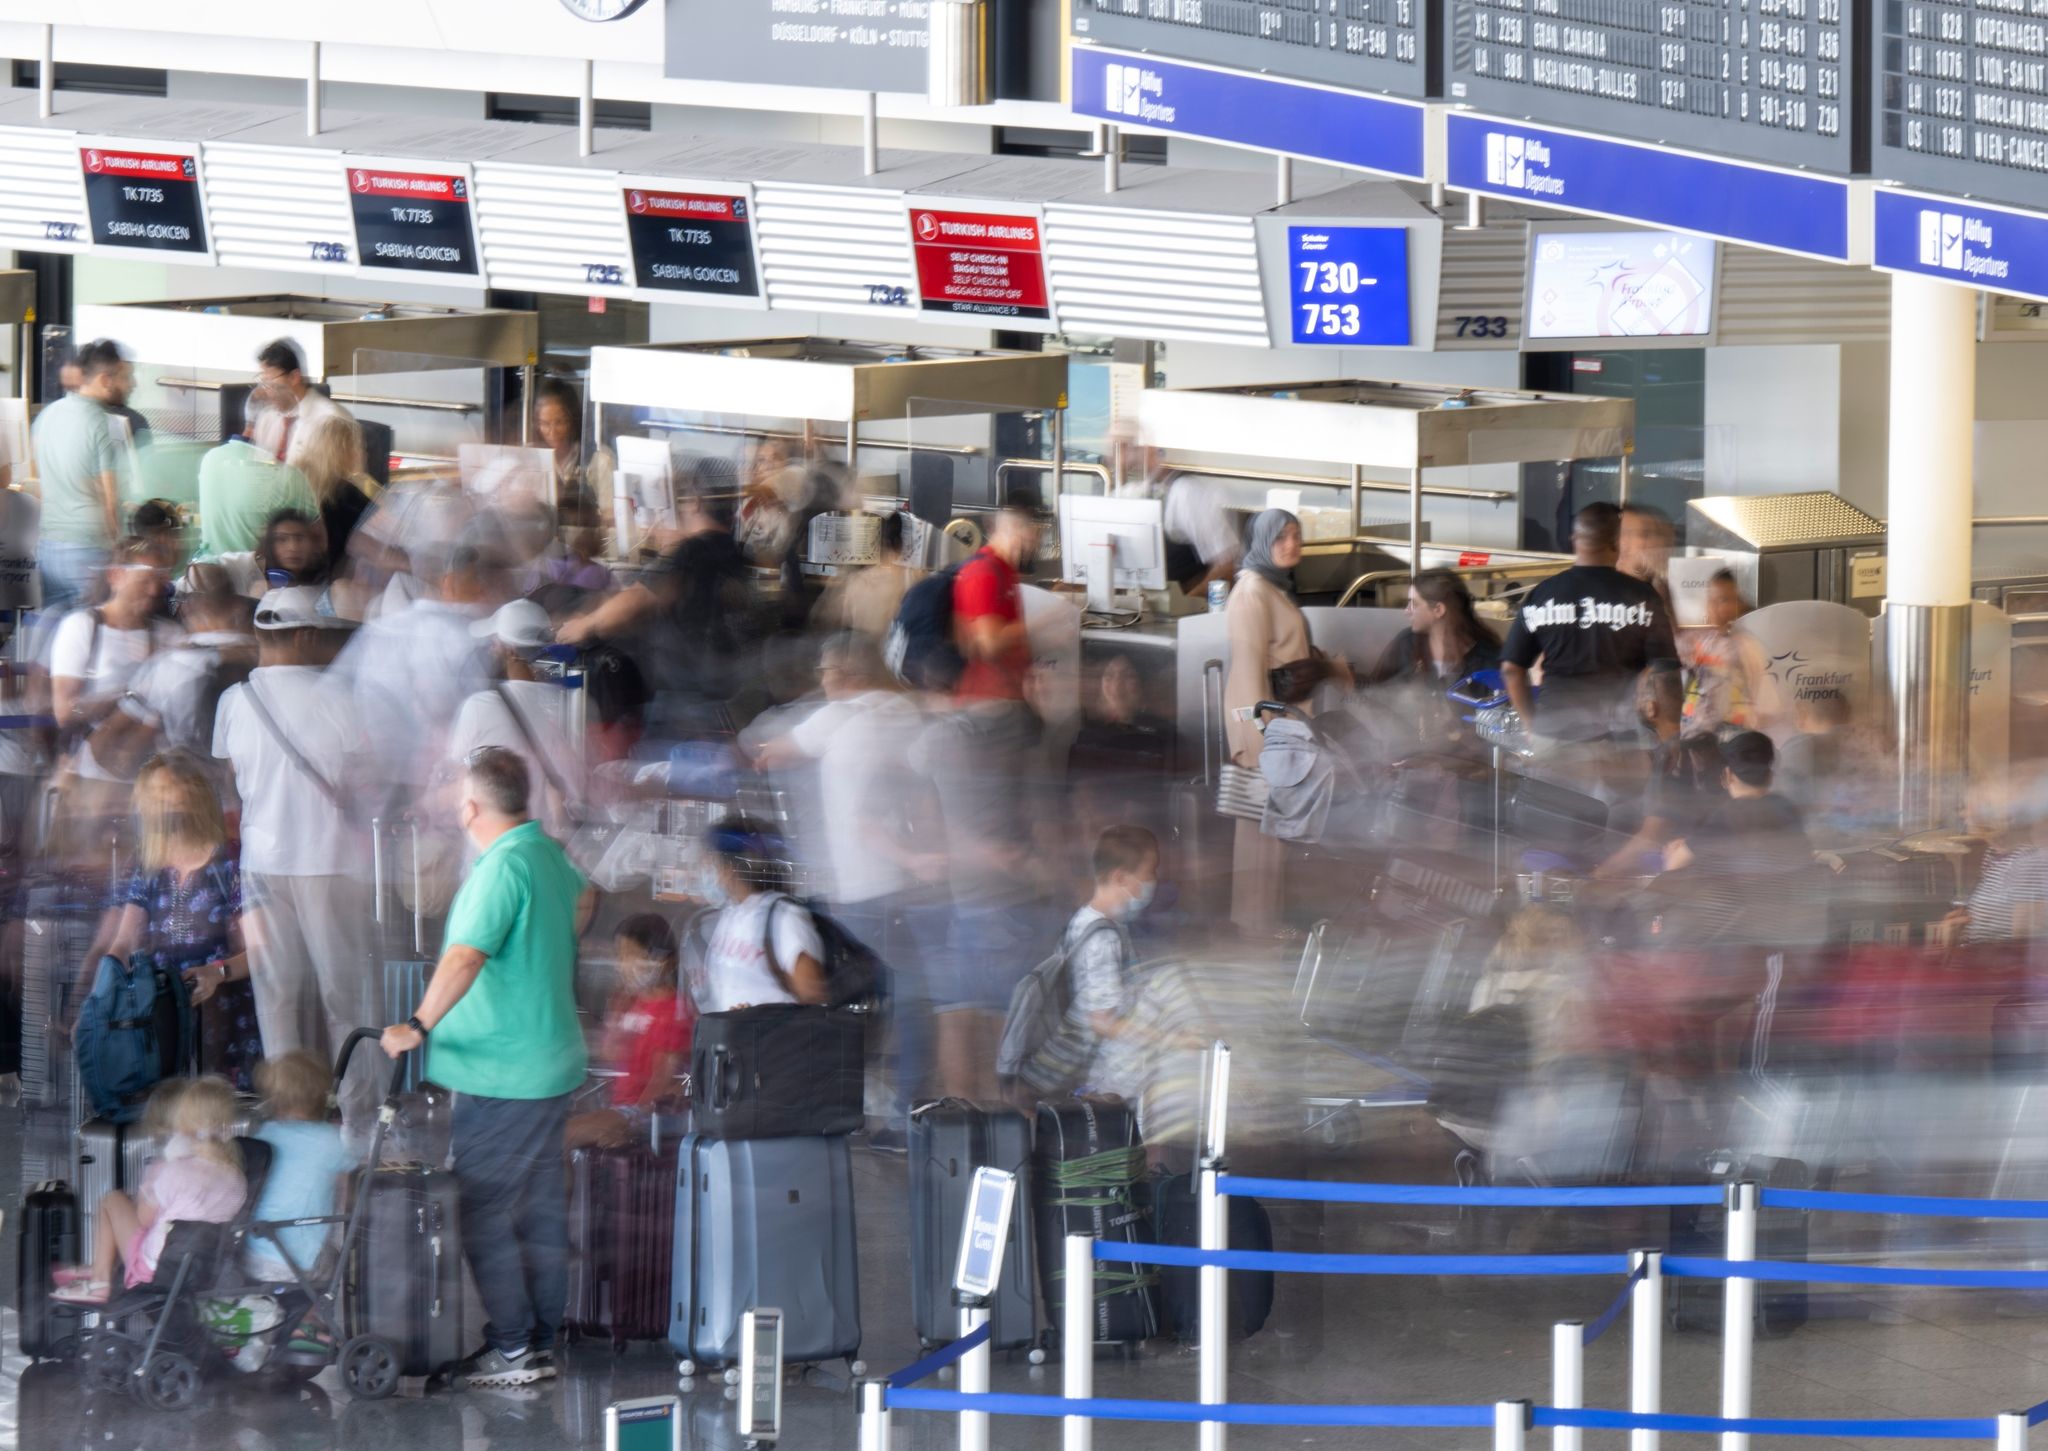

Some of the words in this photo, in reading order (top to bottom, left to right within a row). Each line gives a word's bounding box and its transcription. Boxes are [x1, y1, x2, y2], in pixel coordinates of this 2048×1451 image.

[831, 0, 886, 16] FRANKFURT
[1908, 7, 1922, 33] LH
[1942, 12, 1962, 40] 828
[772, 22, 838, 42] DÜSSELDORF
[850, 25, 878, 45] KÖLN
[1533, 22, 1559, 49] GRAN
[1563, 26, 1607, 57] CANARIA
[1908, 45, 1922, 71] LH
[1936, 49, 1962, 78] 1076
[1533, 57, 1637, 99] WASHINGTON-DULLES
[1908, 82, 1922, 109] LH
[1936, 88, 1962, 116] 1372
[1942, 126, 1962, 154] 130
[104, 156, 139, 170] TURKISH
[140, 158, 178, 172] AIRLINES
[371, 177, 408, 190] TURKISH
[409, 179, 448, 193] AIRLINES
[1525, 168, 1565, 195] Departures
[123, 186, 138, 201] TK
[138, 187, 164, 203] 7735
[648, 197, 687, 210] TURKISH
[687, 200, 727, 213] AIRLINES
[391, 207, 407, 222] TK
[407, 208, 433, 224] 7735
[107, 221, 146, 238] SABIHA
[668, 228, 684, 242] TK
[685, 229, 712, 245] 7735
[939, 221, 986, 238] TURKISH
[987, 223, 1034, 240] AIRLINES
[1963, 217, 1992, 249] Abflug
[375, 242, 413, 259] SABIHA
[652, 263, 692, 280] SABIHA
[1963, 249, 2009, 278] Departures
[944, 286, 984, 297] BAGGAGE
[984, 288, 1005, 298] DROP
[1006, 289, 1023, 300] OFF
[1302, 303, 1360, 336] 753
[1455, 315, 1508, 338] 733
[1795, 672, 1852, 686] Frankfurt
[1794, 688, 1840, 703] Airport
